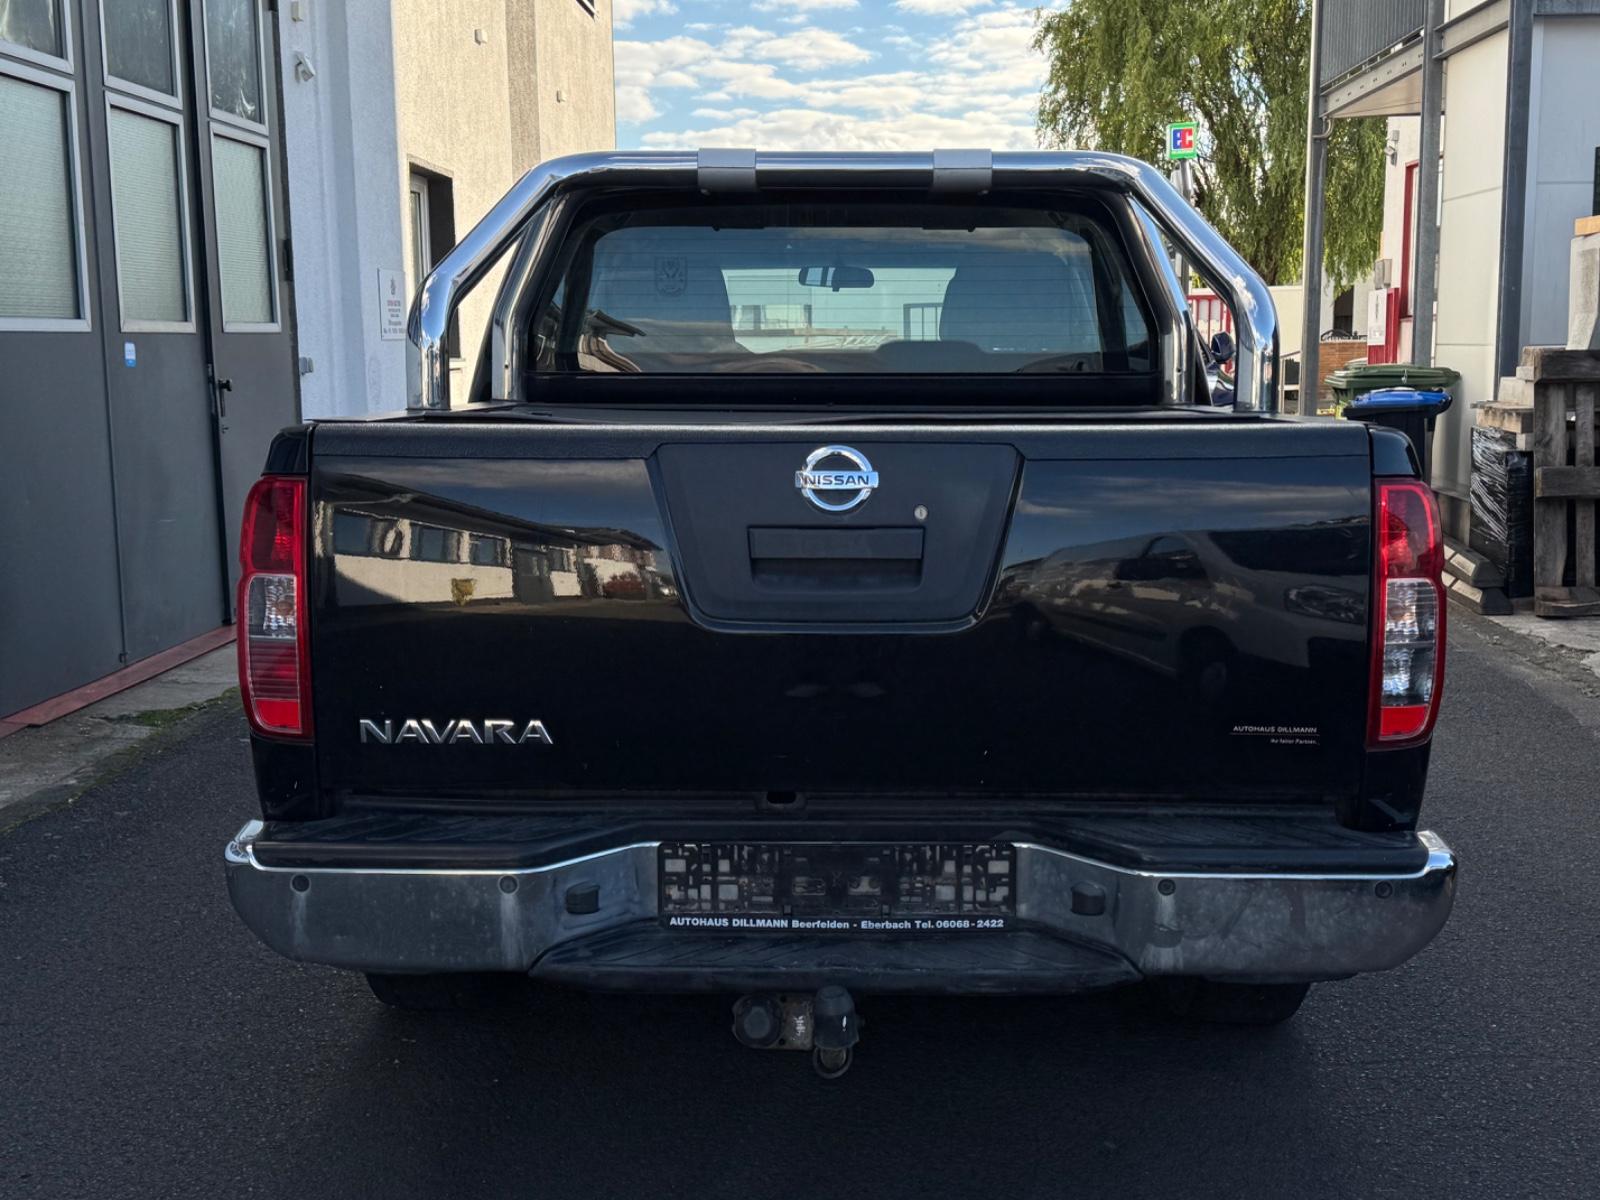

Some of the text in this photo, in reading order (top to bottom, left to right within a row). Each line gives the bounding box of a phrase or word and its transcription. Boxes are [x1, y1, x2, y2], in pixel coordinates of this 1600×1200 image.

[804, 474, 869, 486] NISSAN
[359, 718, 554, 745] NAVARA
[669, 917, 729, 927] AUTOHAUS
[732, 918, 788, 928] DILLMANN
[792, 919, 850, 929] Beerfelden
[861, 920, 912, 930] Eberbach
[915, 920, 934, 930] Tel.
